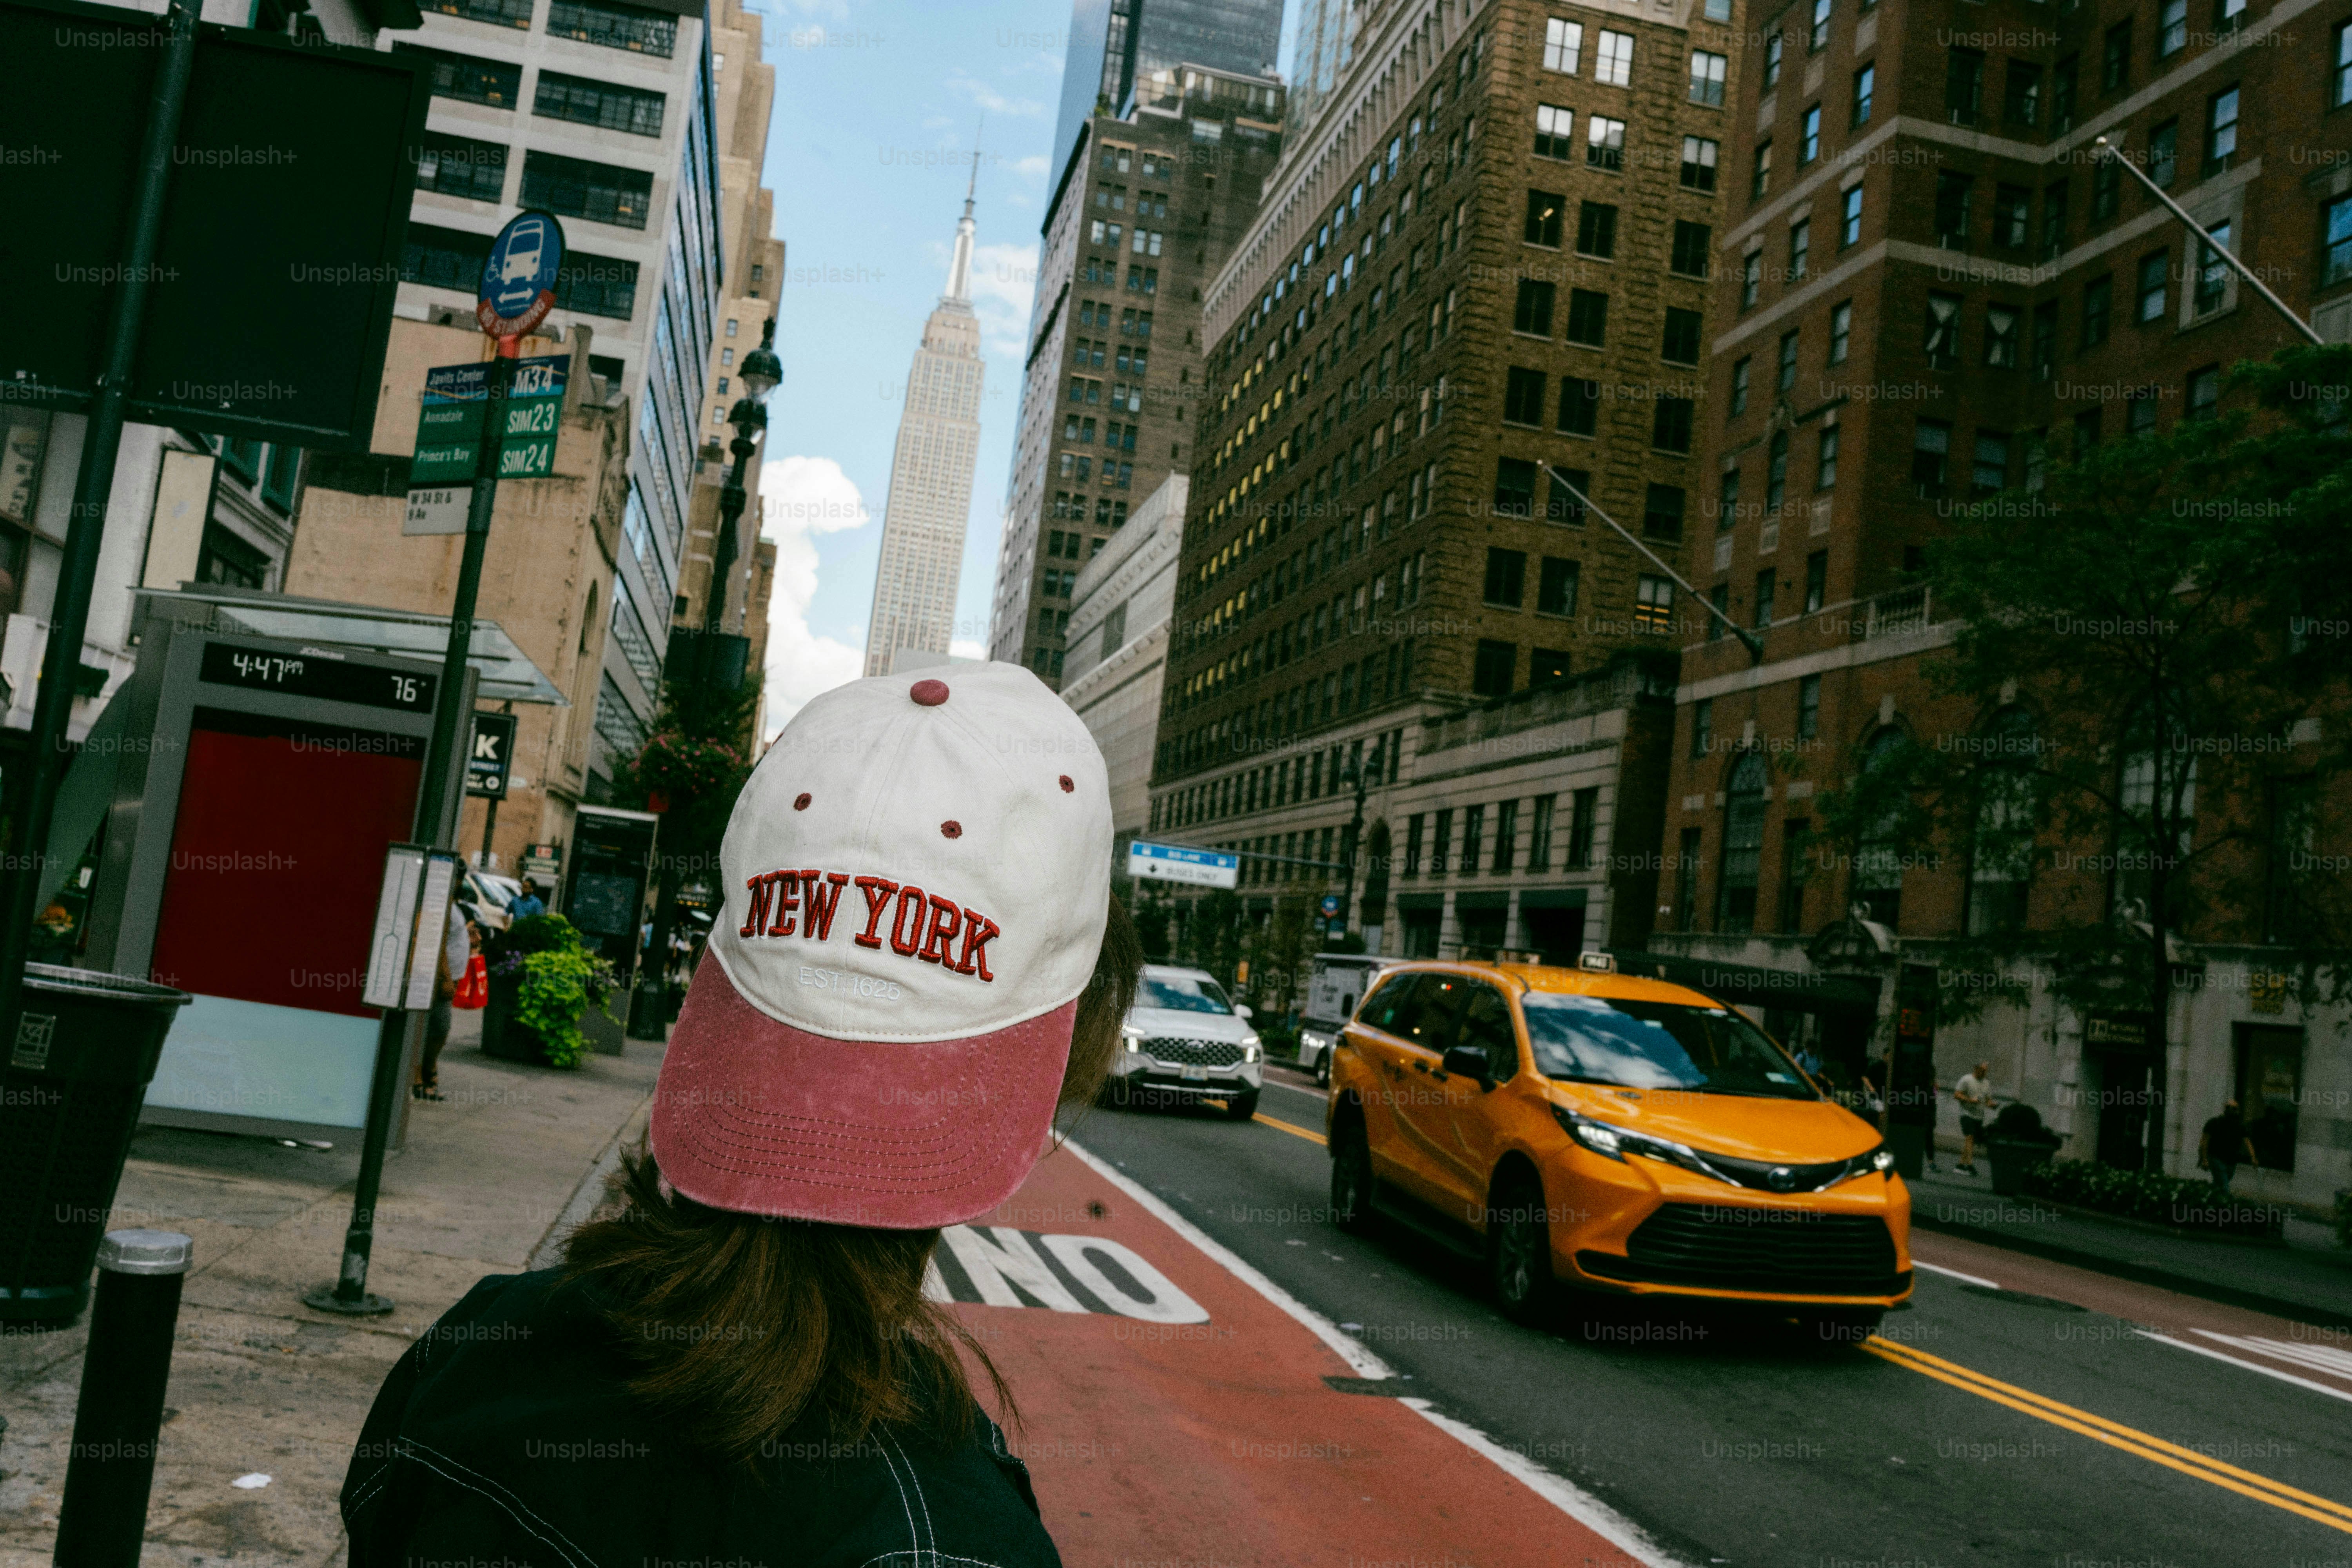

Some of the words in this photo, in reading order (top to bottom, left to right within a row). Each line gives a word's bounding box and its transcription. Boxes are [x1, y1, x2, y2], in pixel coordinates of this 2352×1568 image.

[456, 370, 485, 383] Center
[514, 364, 554, 394] M34
[508, 403, 555, 433] SIM23
[501, 444, 548, 473] SIM24
[739, 868, 851, 942] NEW
[853, 874, 1001, 983] YORK
[851, 975, 900, 1000] 1625
